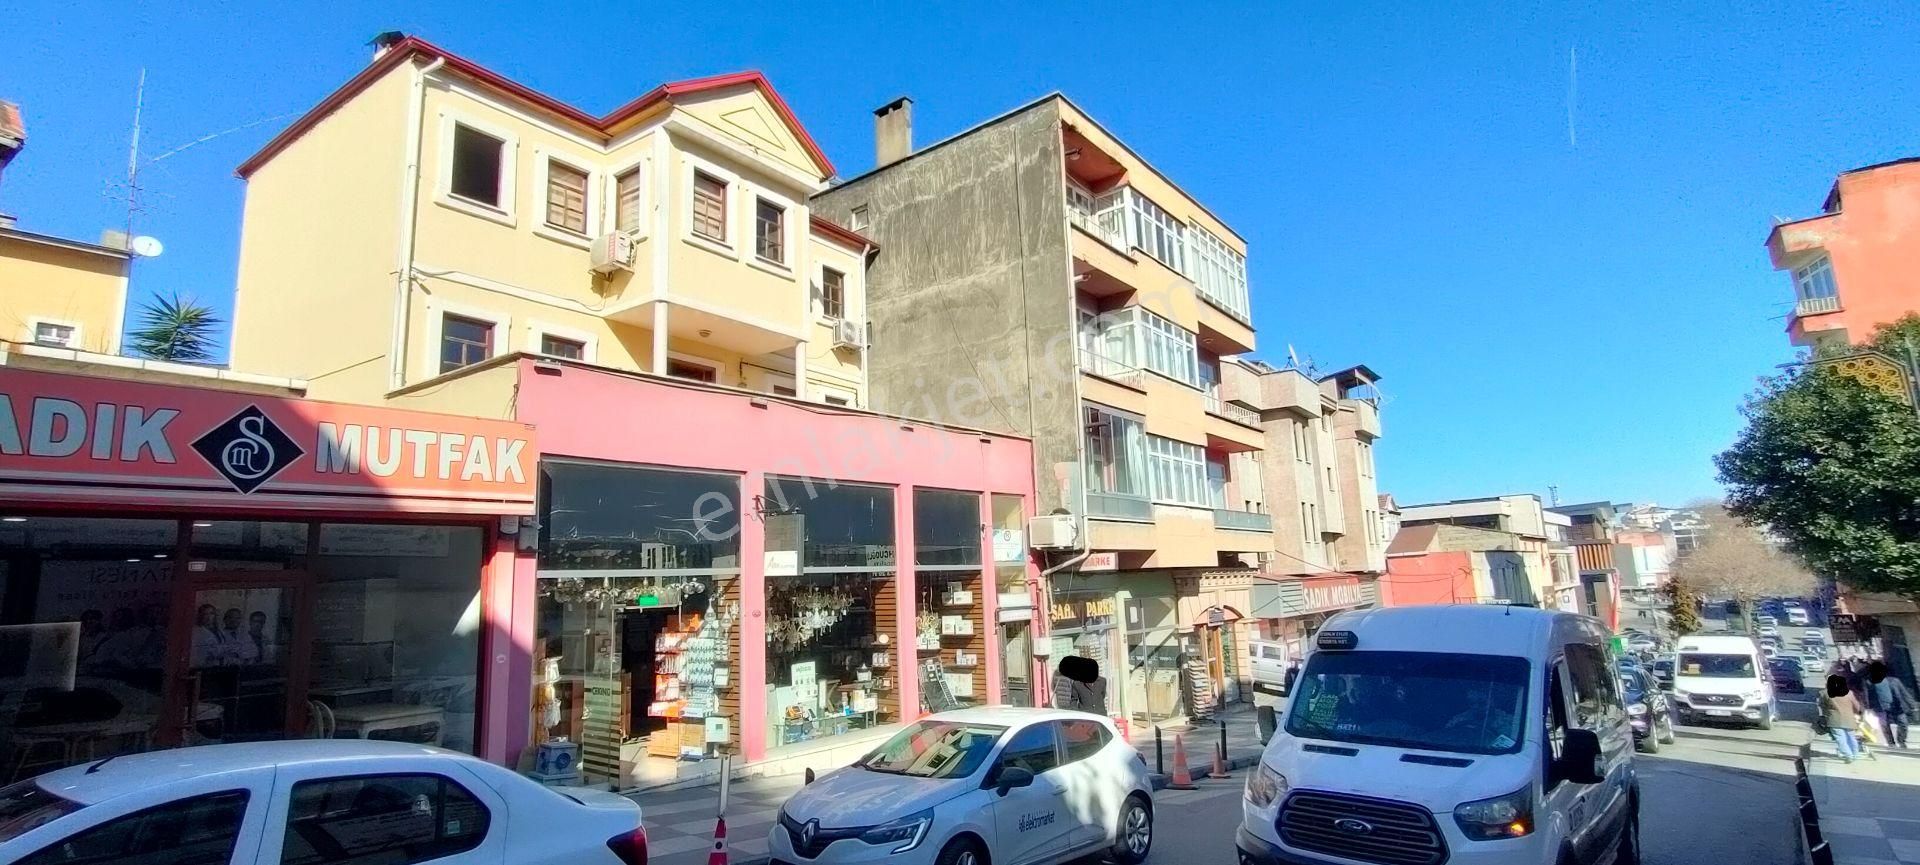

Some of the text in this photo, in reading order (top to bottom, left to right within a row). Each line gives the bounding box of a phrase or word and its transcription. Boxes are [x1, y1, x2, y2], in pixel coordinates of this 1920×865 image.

[314, 421, 528, 484] MUTFAK
[1086, 598, 1114, 617] PARKE
[1304, 587, 1329, 609] SADIK
